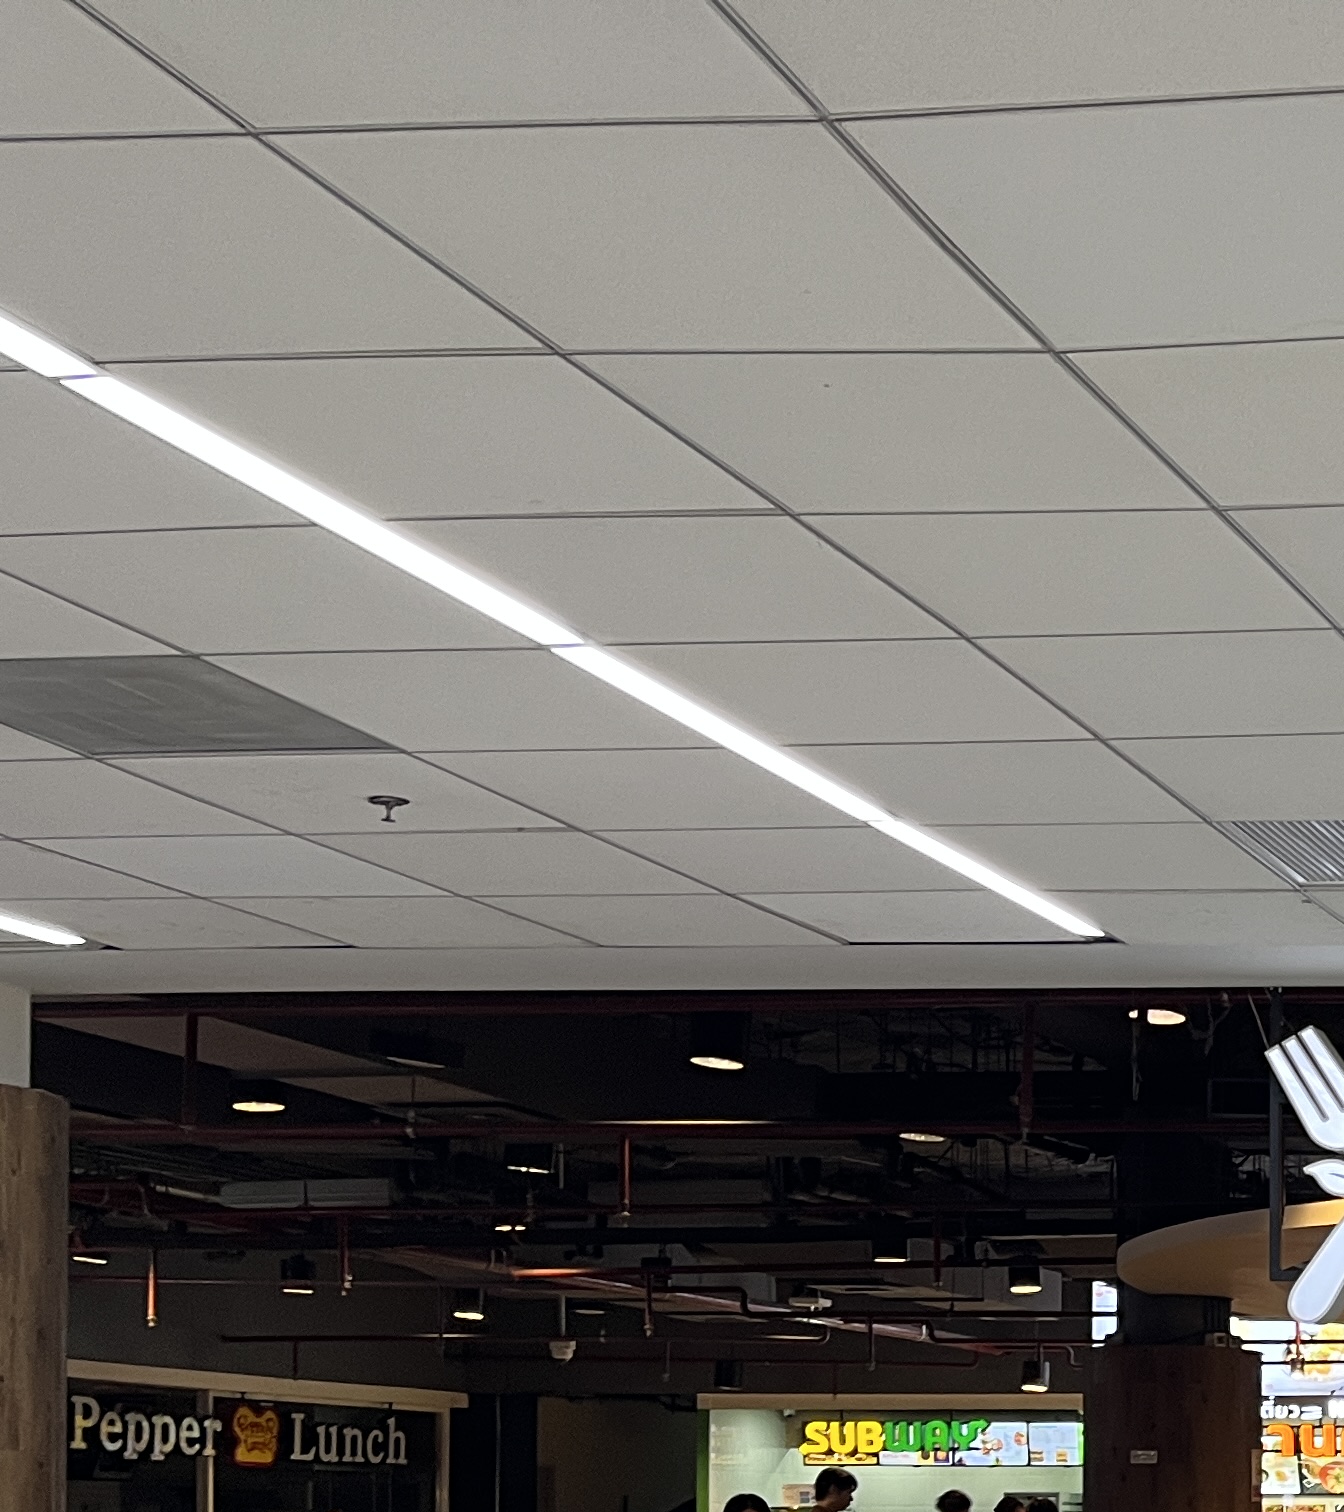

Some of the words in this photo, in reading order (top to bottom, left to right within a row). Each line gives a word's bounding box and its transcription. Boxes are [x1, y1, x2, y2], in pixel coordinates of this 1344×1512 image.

[70, 1395, 223, 1461] Pepper
[290, 1411, 408, 1466] Lunch
[798, 1419, 990, 1455] SUBWAY
